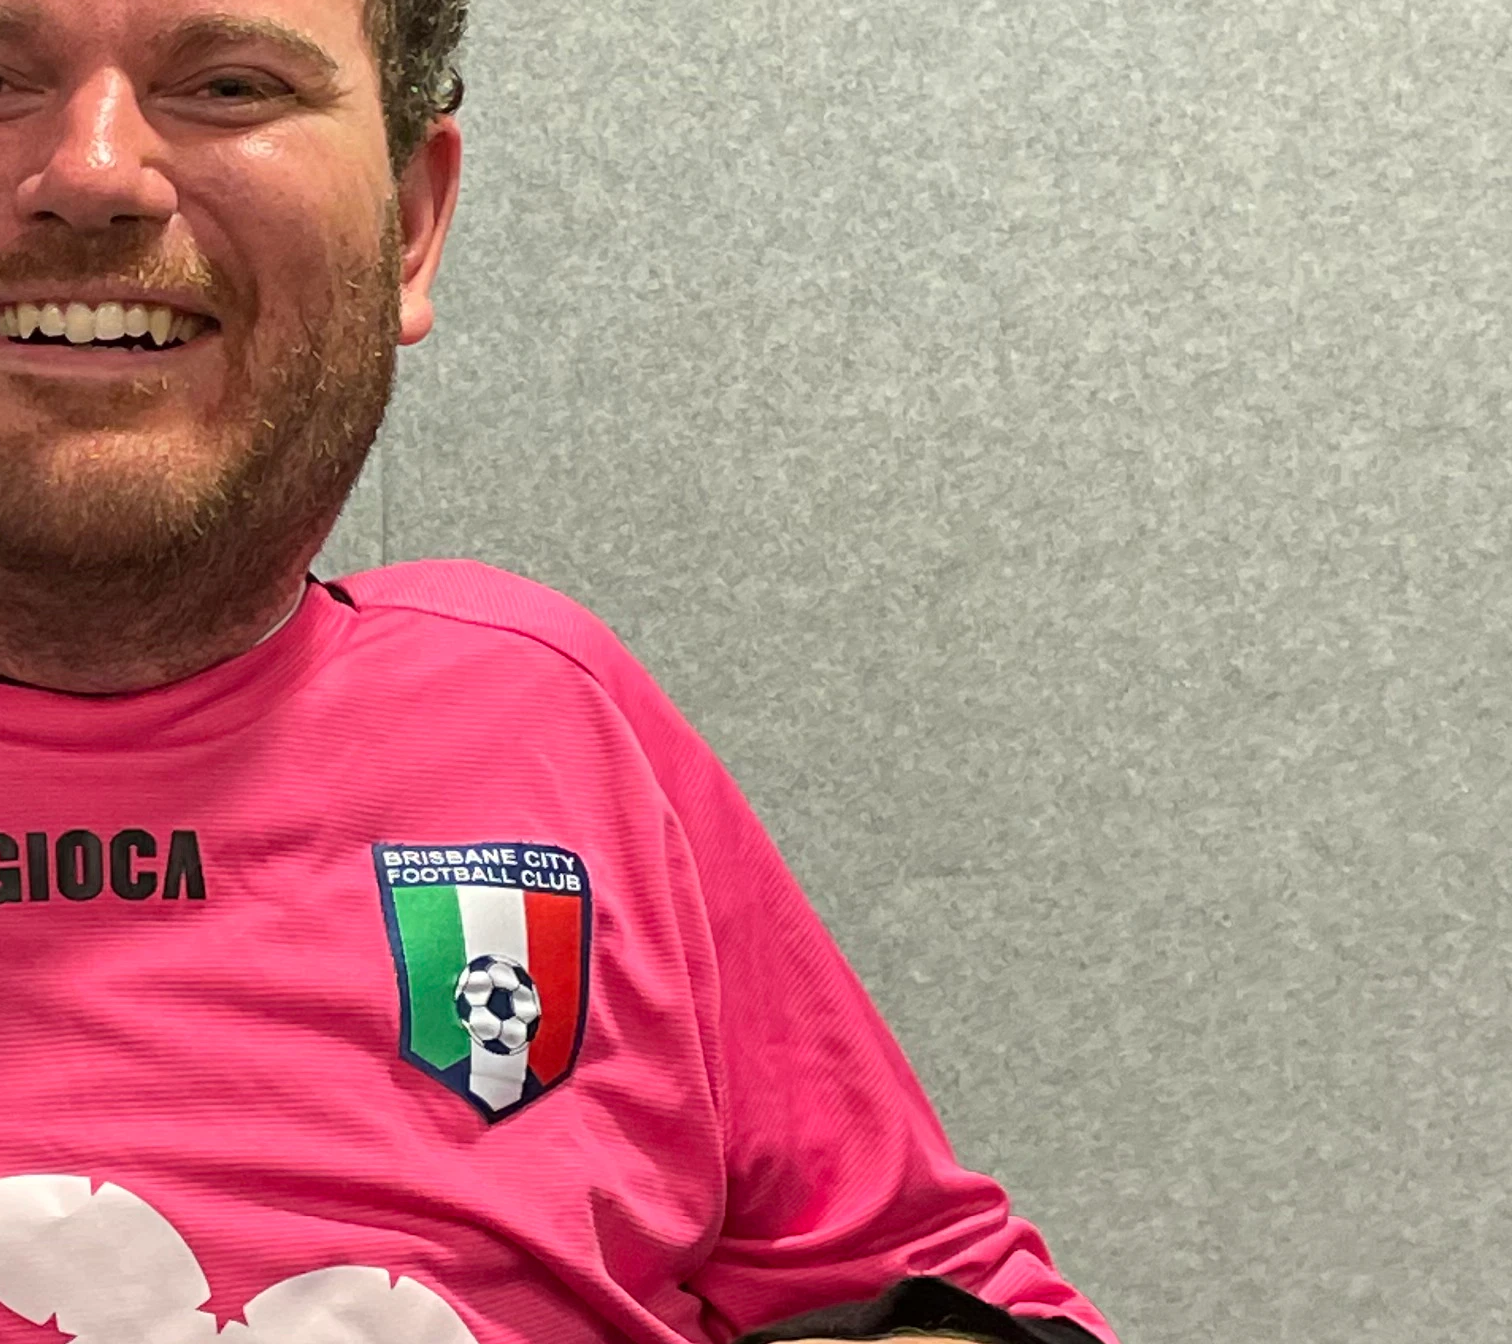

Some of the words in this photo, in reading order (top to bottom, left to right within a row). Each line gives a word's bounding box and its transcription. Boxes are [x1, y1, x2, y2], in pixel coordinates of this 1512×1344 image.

[382, 848, 518, 867] BRISBANE
[523, 850, 575, 871] CITY
[386, 867, 517, 885] FOOTBALL
[520, 869, 582, 891] CLUB
